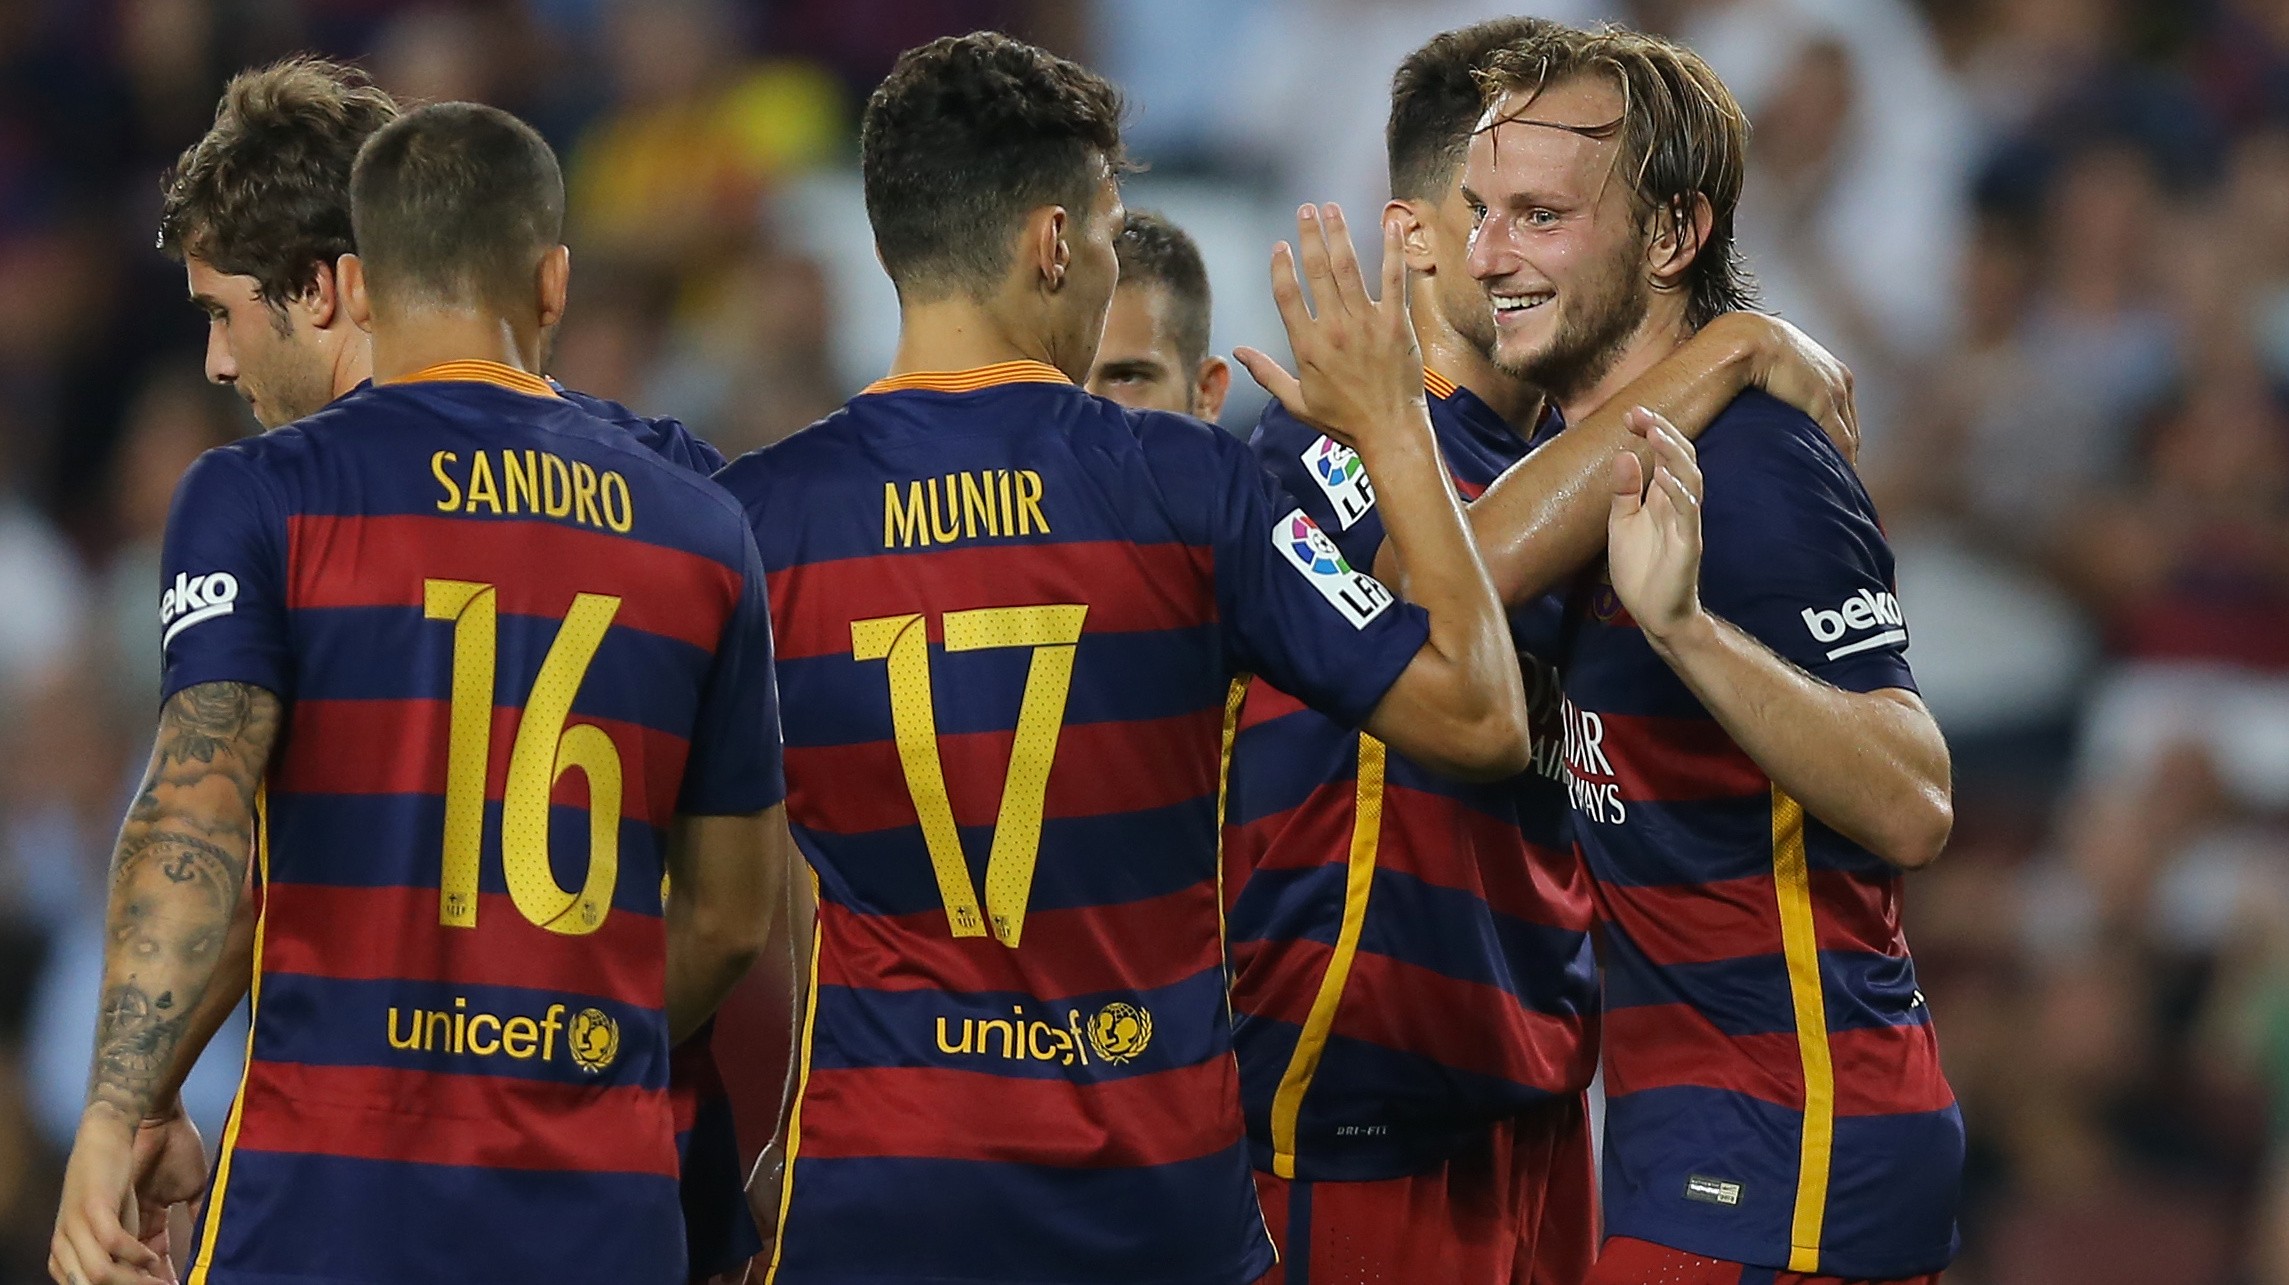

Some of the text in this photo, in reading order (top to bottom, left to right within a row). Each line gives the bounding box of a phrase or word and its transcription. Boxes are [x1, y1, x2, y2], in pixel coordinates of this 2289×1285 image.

[430, 449, 634, 534] SANDRO
[884, 469, 1051, 548] MUNIR
[1342, 472, 1371, 520] LF
[160, 571, 239, 624] eko
[1801, 588, 1904, 643] beko
[424, 578, 622, 935] 16
[850, 604, 1089, 948] 17
[387, 997, 566, 1061] unicef
[936, 1005, 1089, 1066] unicef
